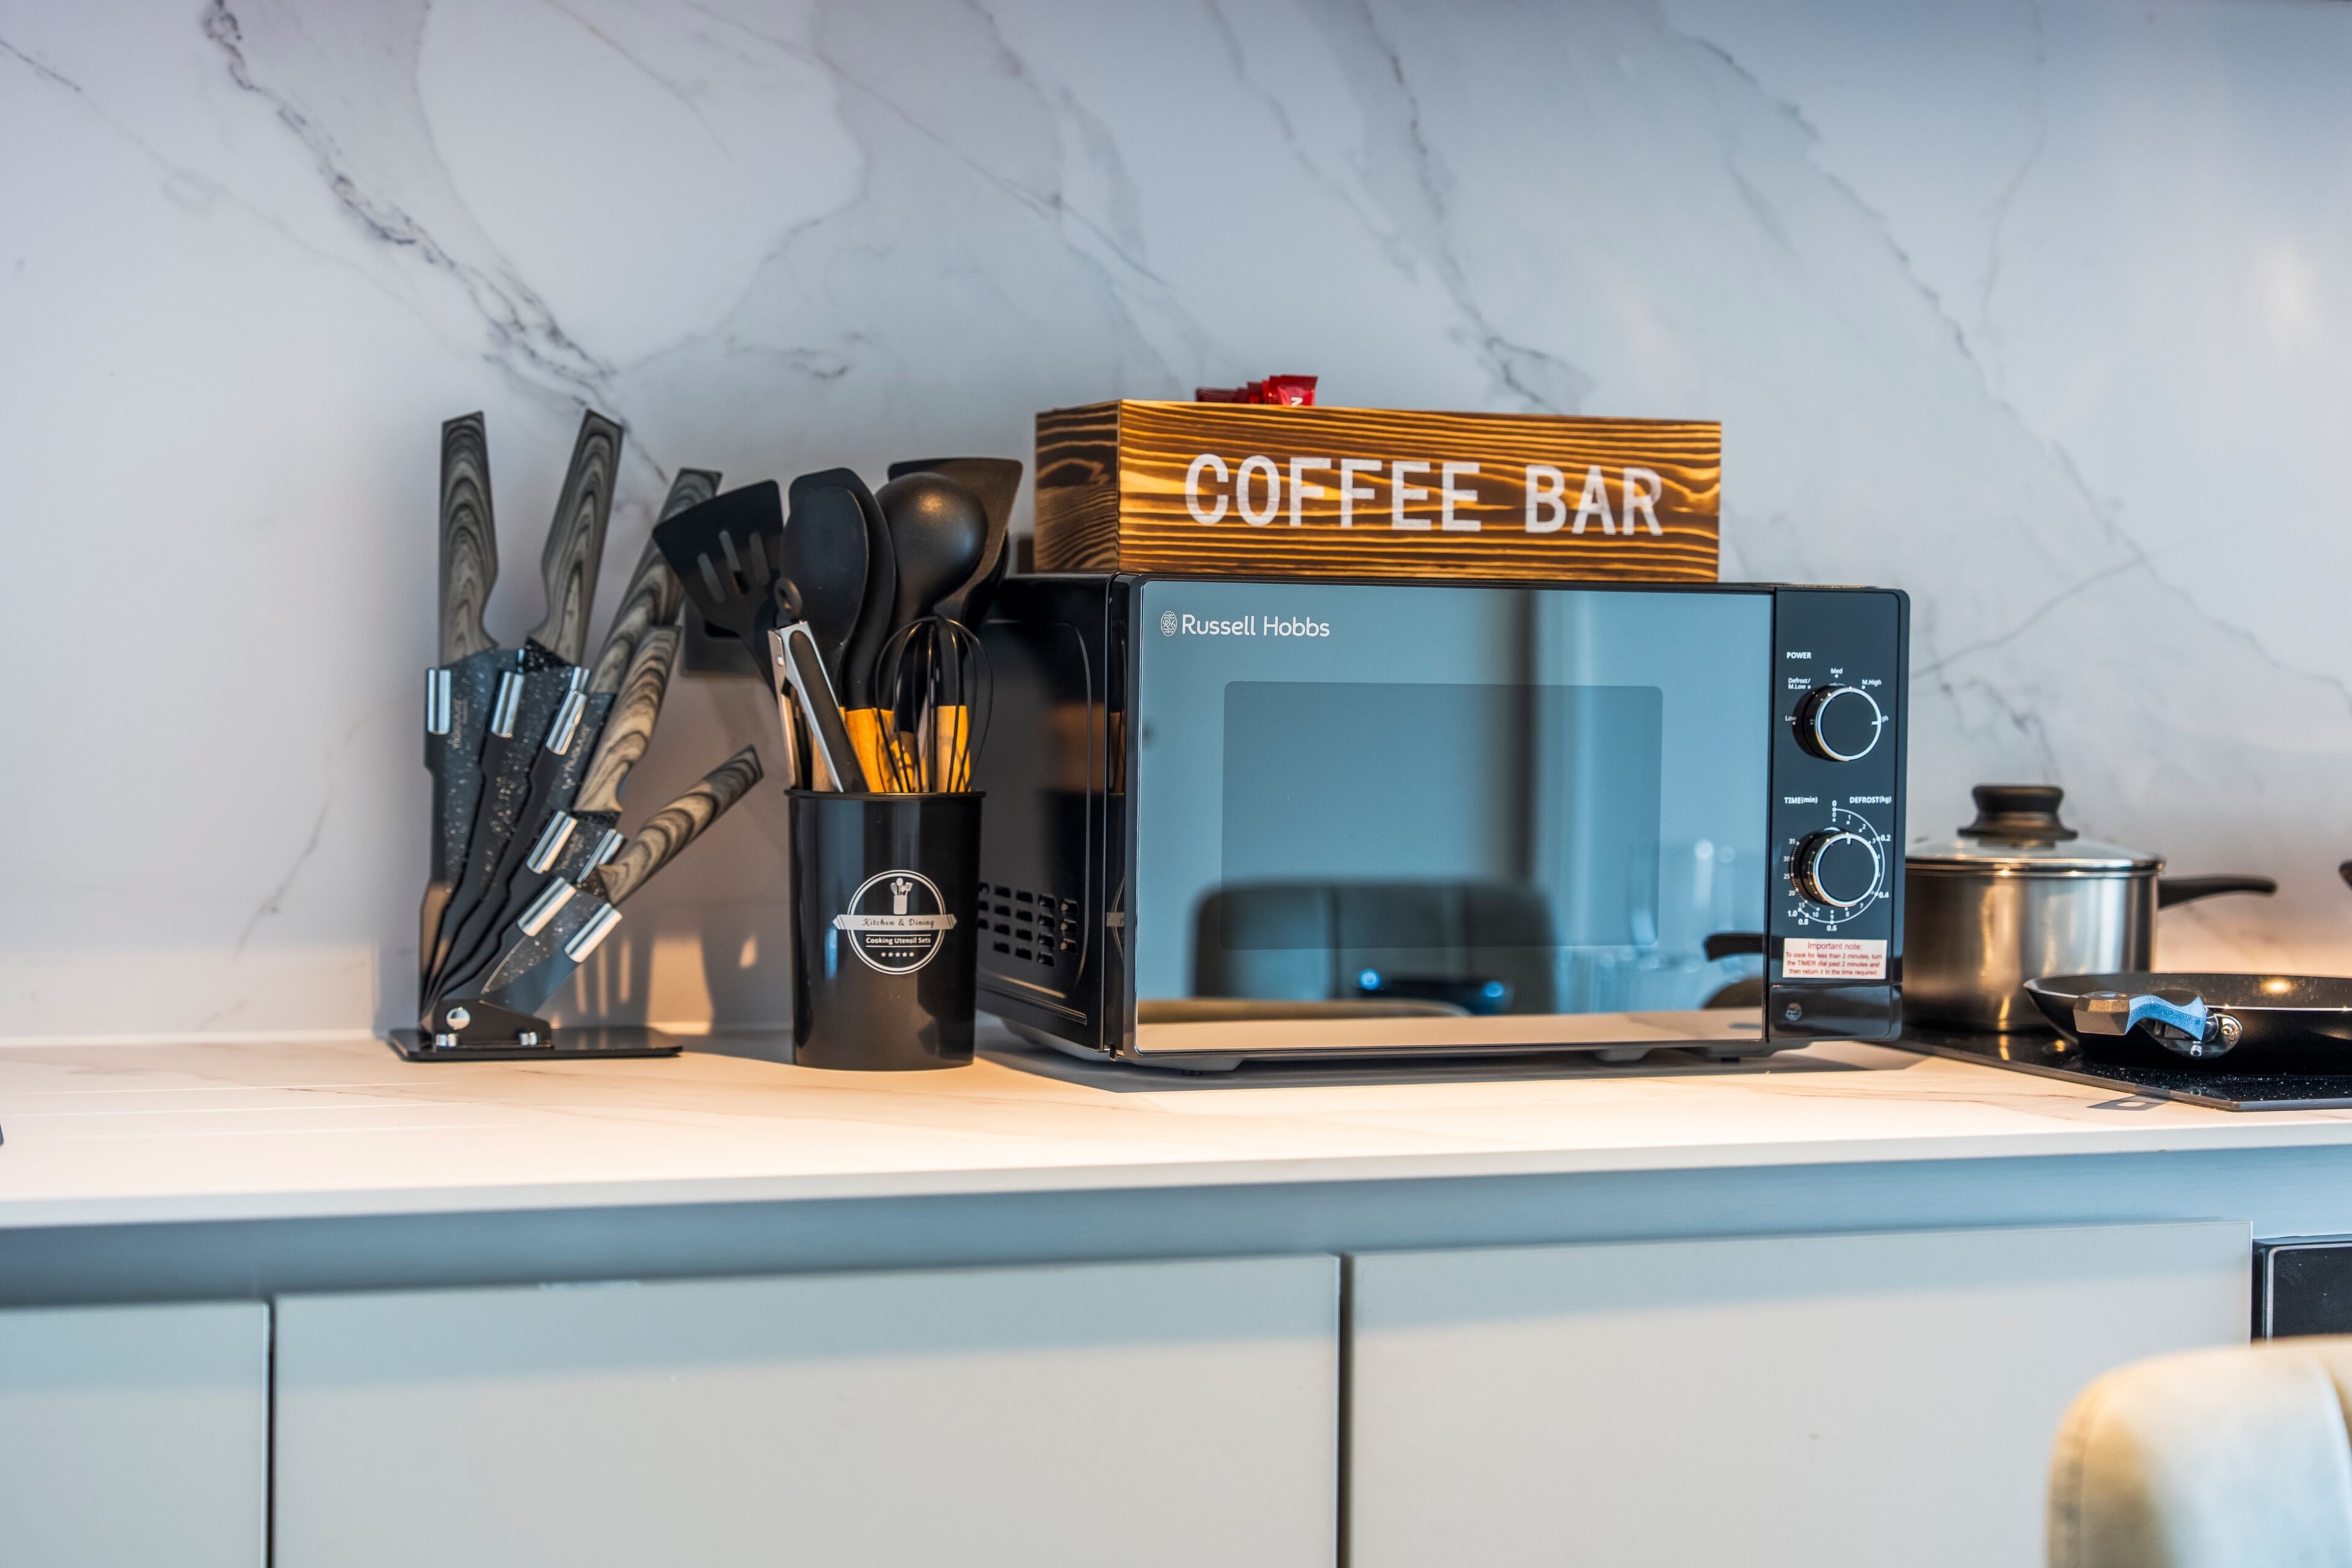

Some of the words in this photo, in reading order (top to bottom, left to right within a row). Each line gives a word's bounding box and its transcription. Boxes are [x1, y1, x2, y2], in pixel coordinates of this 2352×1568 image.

[1185, 453, 1482, 532] COFFEE
[1525, 464, 1664, 537] BAR
[1182, 614, 1256, 636] Russell
[1263, 616, 1330, 637] Hobbs
[1861, 679, 1882, 687] M.High
[1784, 796, 1819, 804] TIME(min)
[1849, 796, 1892, 804] DEFROST(kg)
[1880, 834, 1891, 842] 0.2
[862, 918, 895, 927] Kitchen
[909, 918, 935, 929] Dining
[865, 937, 894, 945] Cooking
[1807, 941, 1842, 950] Important
